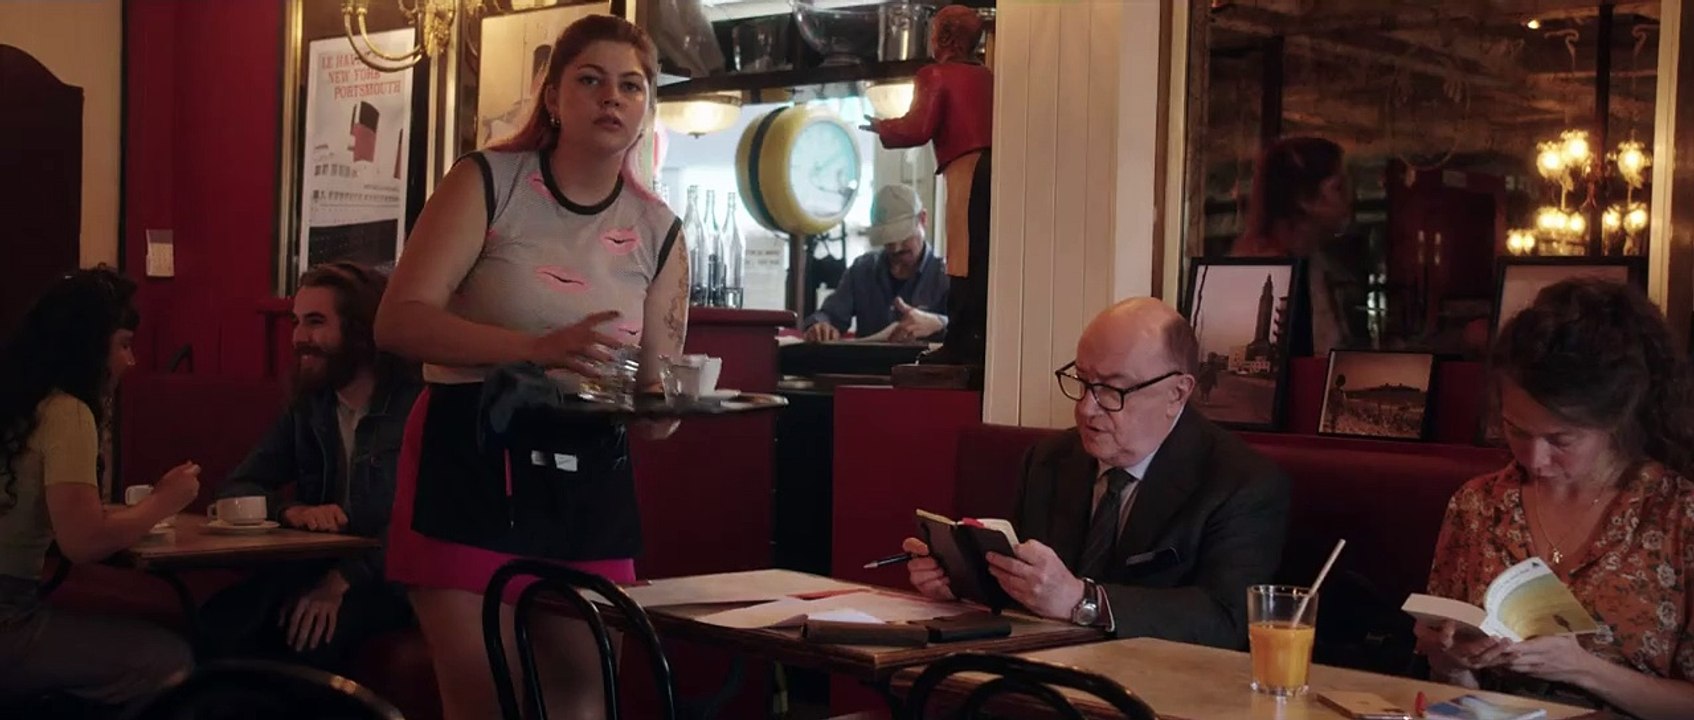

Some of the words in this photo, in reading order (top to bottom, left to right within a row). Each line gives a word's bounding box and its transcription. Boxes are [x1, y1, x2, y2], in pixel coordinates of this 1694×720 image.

[322, 55, 333, 70] LE
[336, 53, 366, 69] HAV
[328, 70, 349, 84] NEW
[353, 67, 381, 82] YORK
[334, 80, 401, 100] PORTSMOUTH
